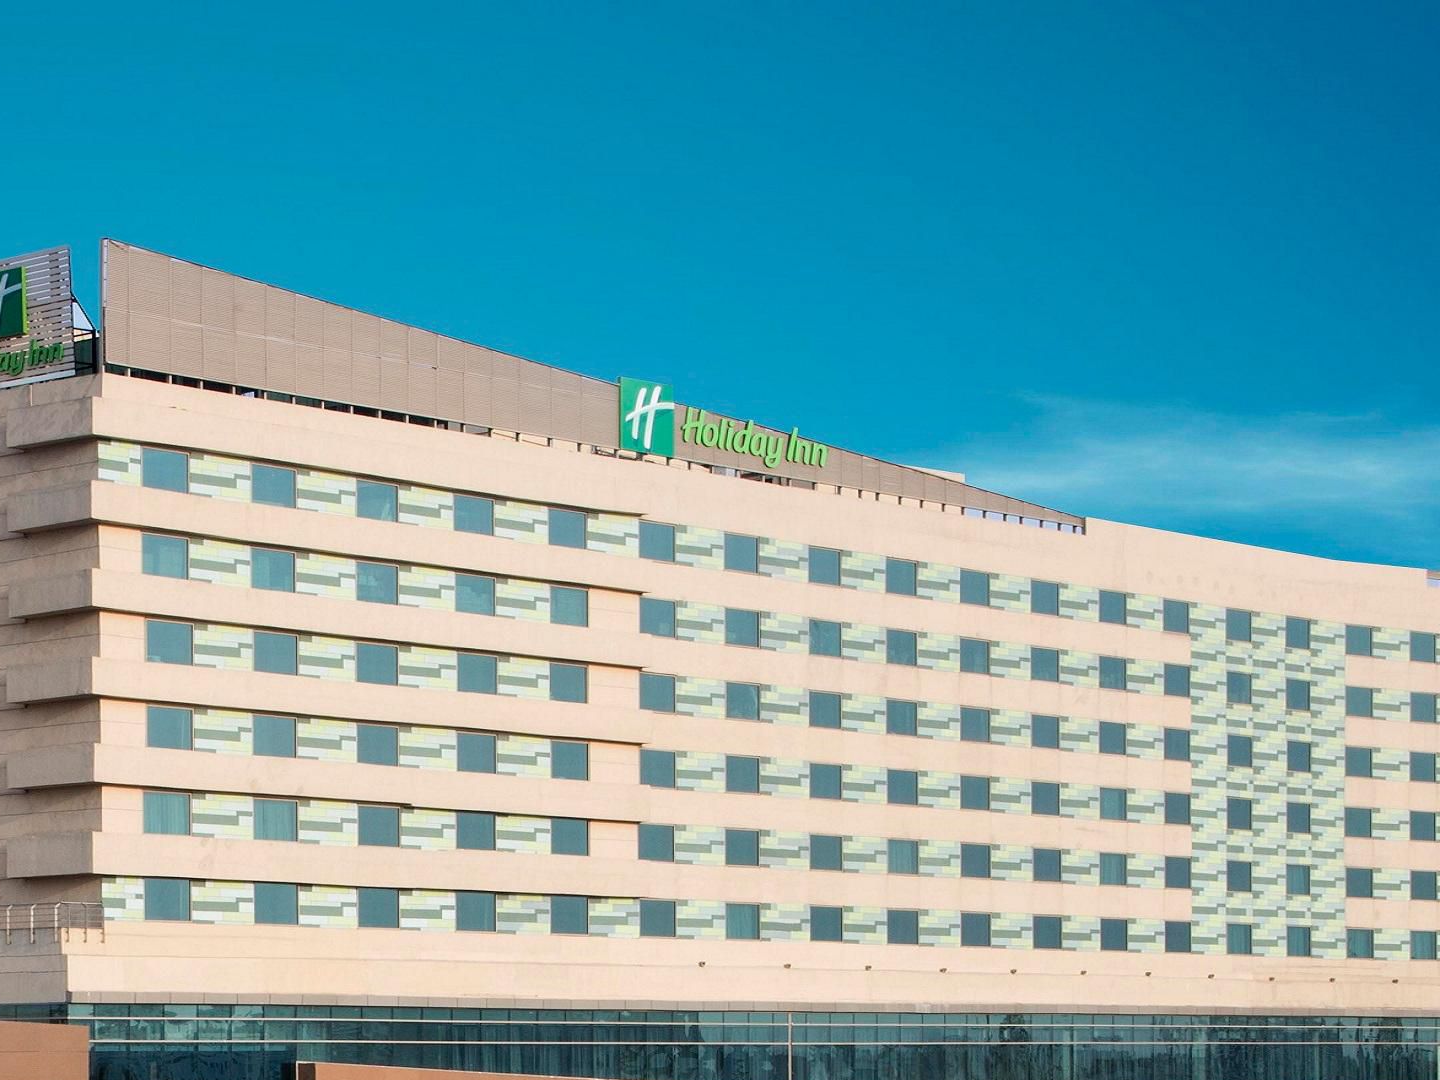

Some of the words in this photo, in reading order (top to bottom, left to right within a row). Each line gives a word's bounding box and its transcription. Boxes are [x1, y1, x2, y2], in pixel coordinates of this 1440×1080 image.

[29, 340, 64, 365] Inn
[681, 407, 784, 468] Holiday
[786, 427, 830, 467] Inn
